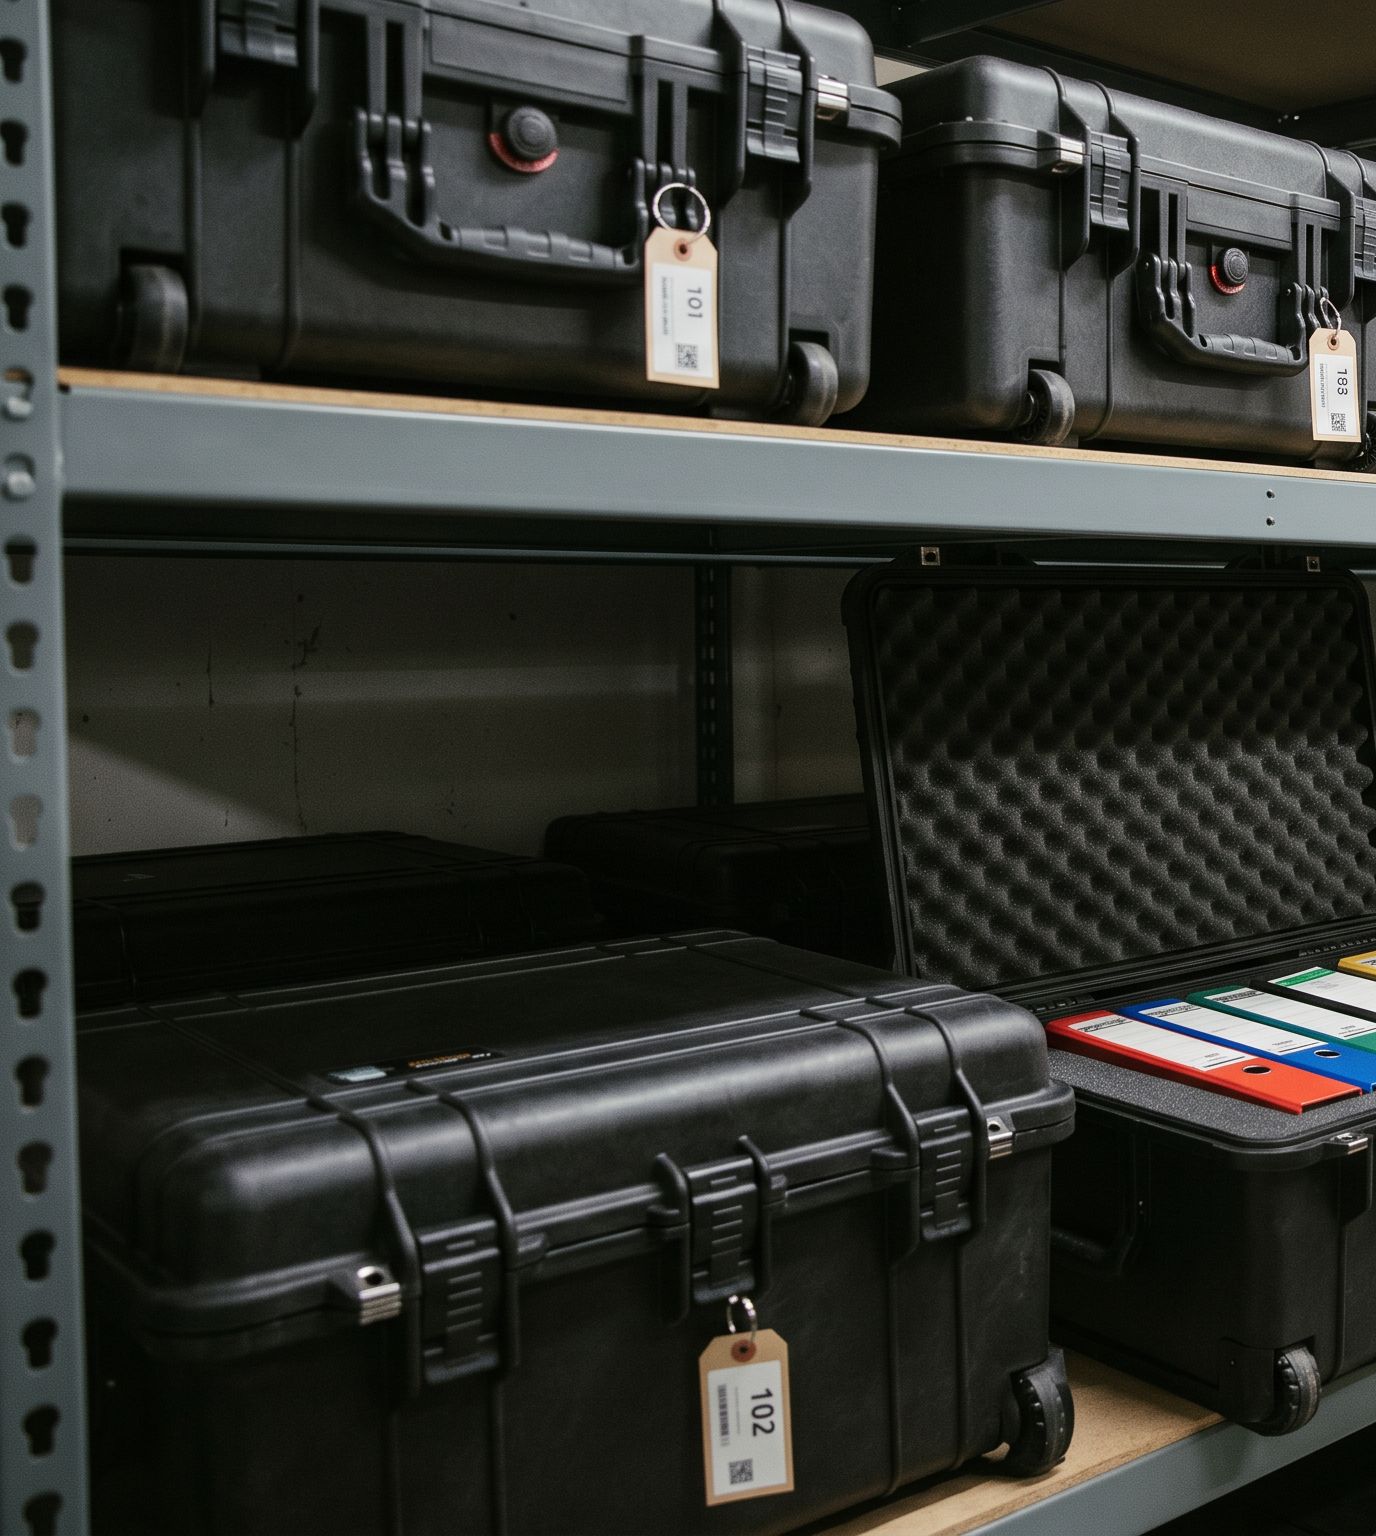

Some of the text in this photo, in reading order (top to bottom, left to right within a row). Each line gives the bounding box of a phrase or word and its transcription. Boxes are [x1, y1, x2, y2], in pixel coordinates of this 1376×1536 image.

[687, 287, 704, 319] 101
[1336, 368, 1349, 396] 183
[750, 1387, 776, 1437] 102
